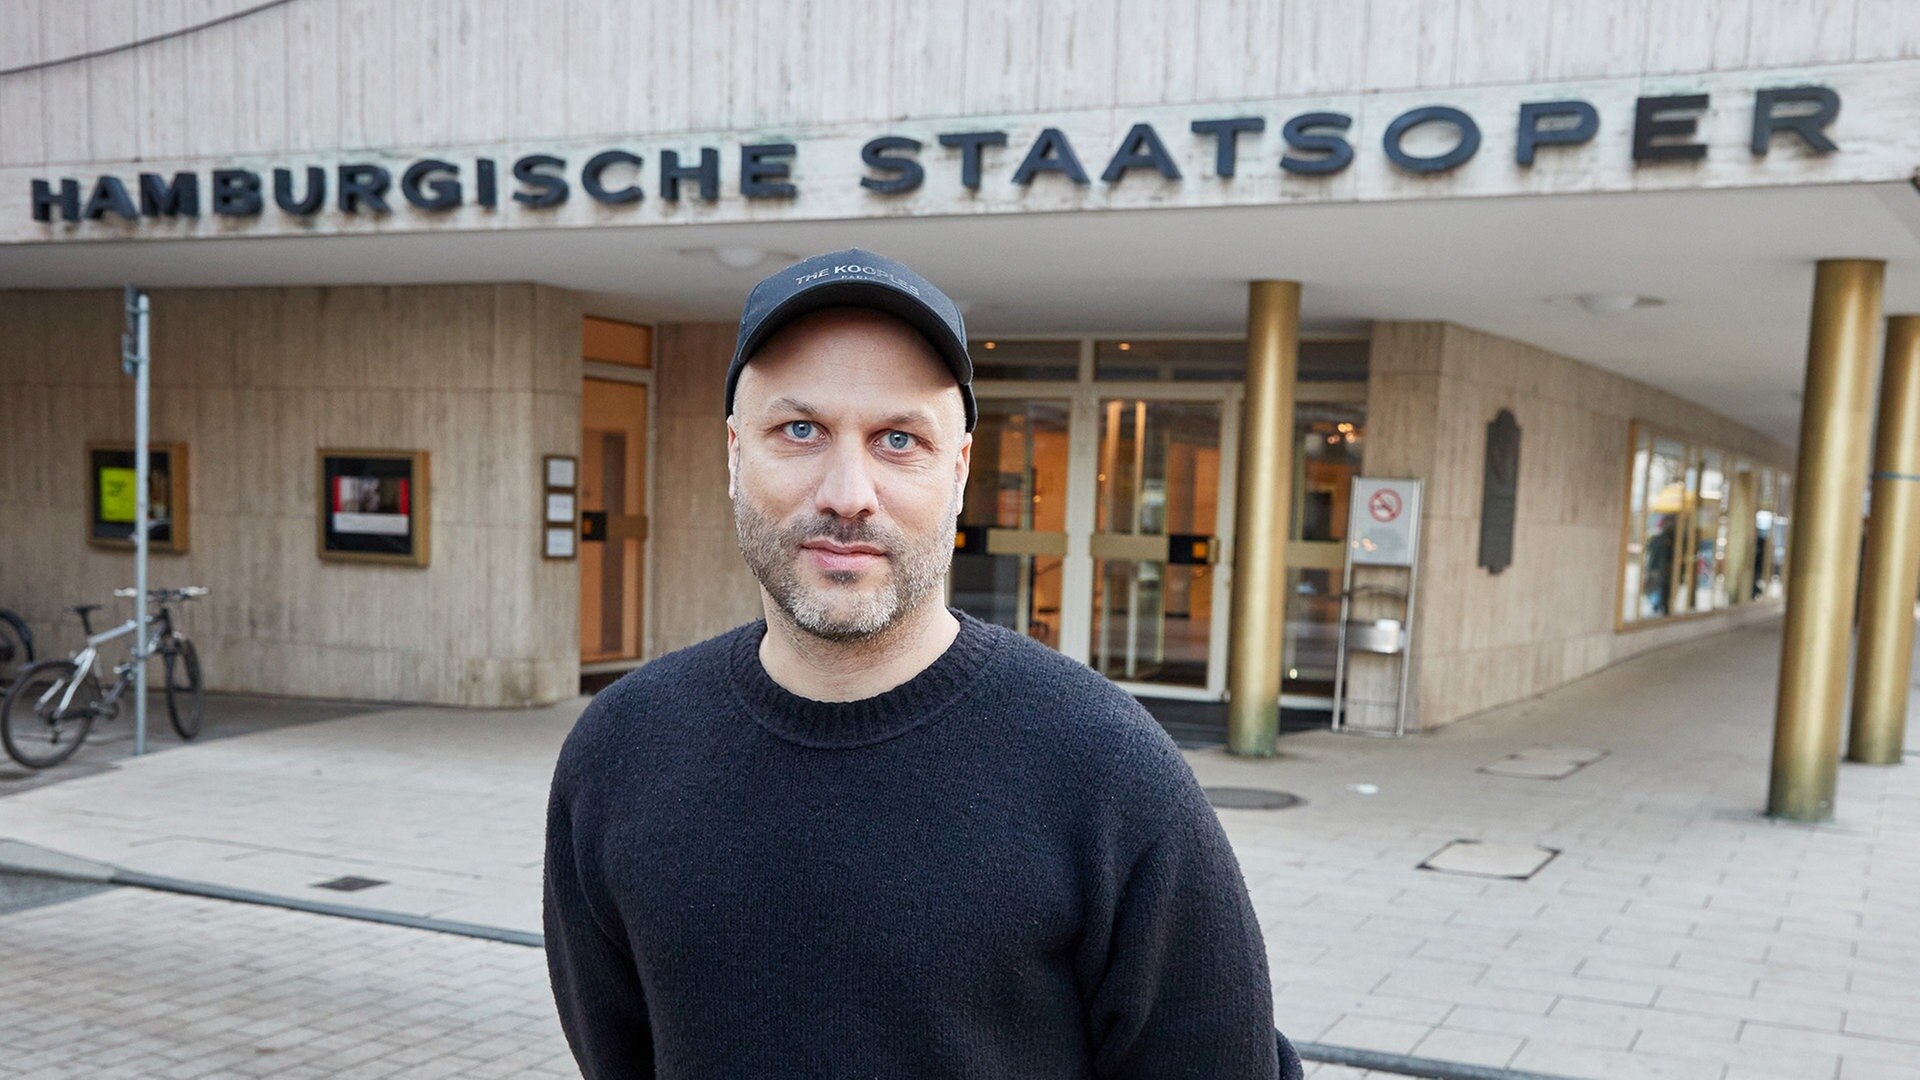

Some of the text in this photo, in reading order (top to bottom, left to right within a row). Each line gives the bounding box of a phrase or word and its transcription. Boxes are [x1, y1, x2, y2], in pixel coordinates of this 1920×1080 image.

[31, 85, 1841, 223] HAMBURGISCHE STAATSOPER
[795, 268, 829, 284] THE
